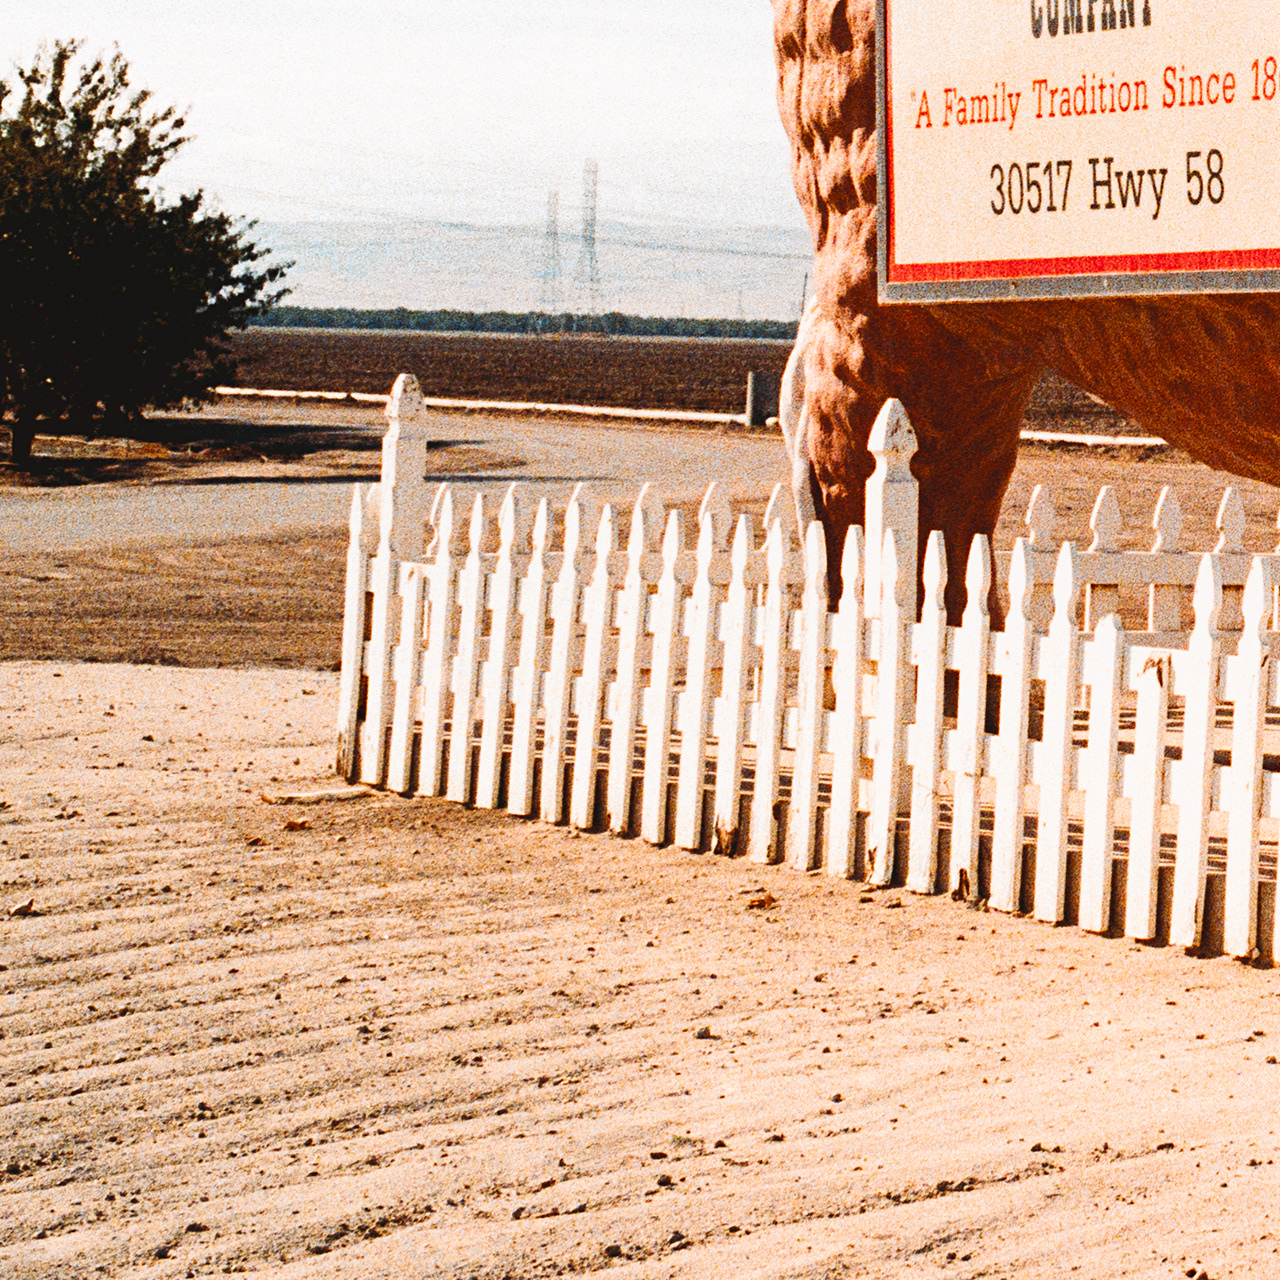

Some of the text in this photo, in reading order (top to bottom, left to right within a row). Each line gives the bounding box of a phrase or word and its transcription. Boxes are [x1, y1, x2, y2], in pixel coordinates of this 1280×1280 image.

[943, 80, 1021, 131] Family
[1032, 70, 1149, 119] Tradition
[1162, 65, 1236, 108] Since
[989, 148, 1225, 220] 30517 Hwy 58
